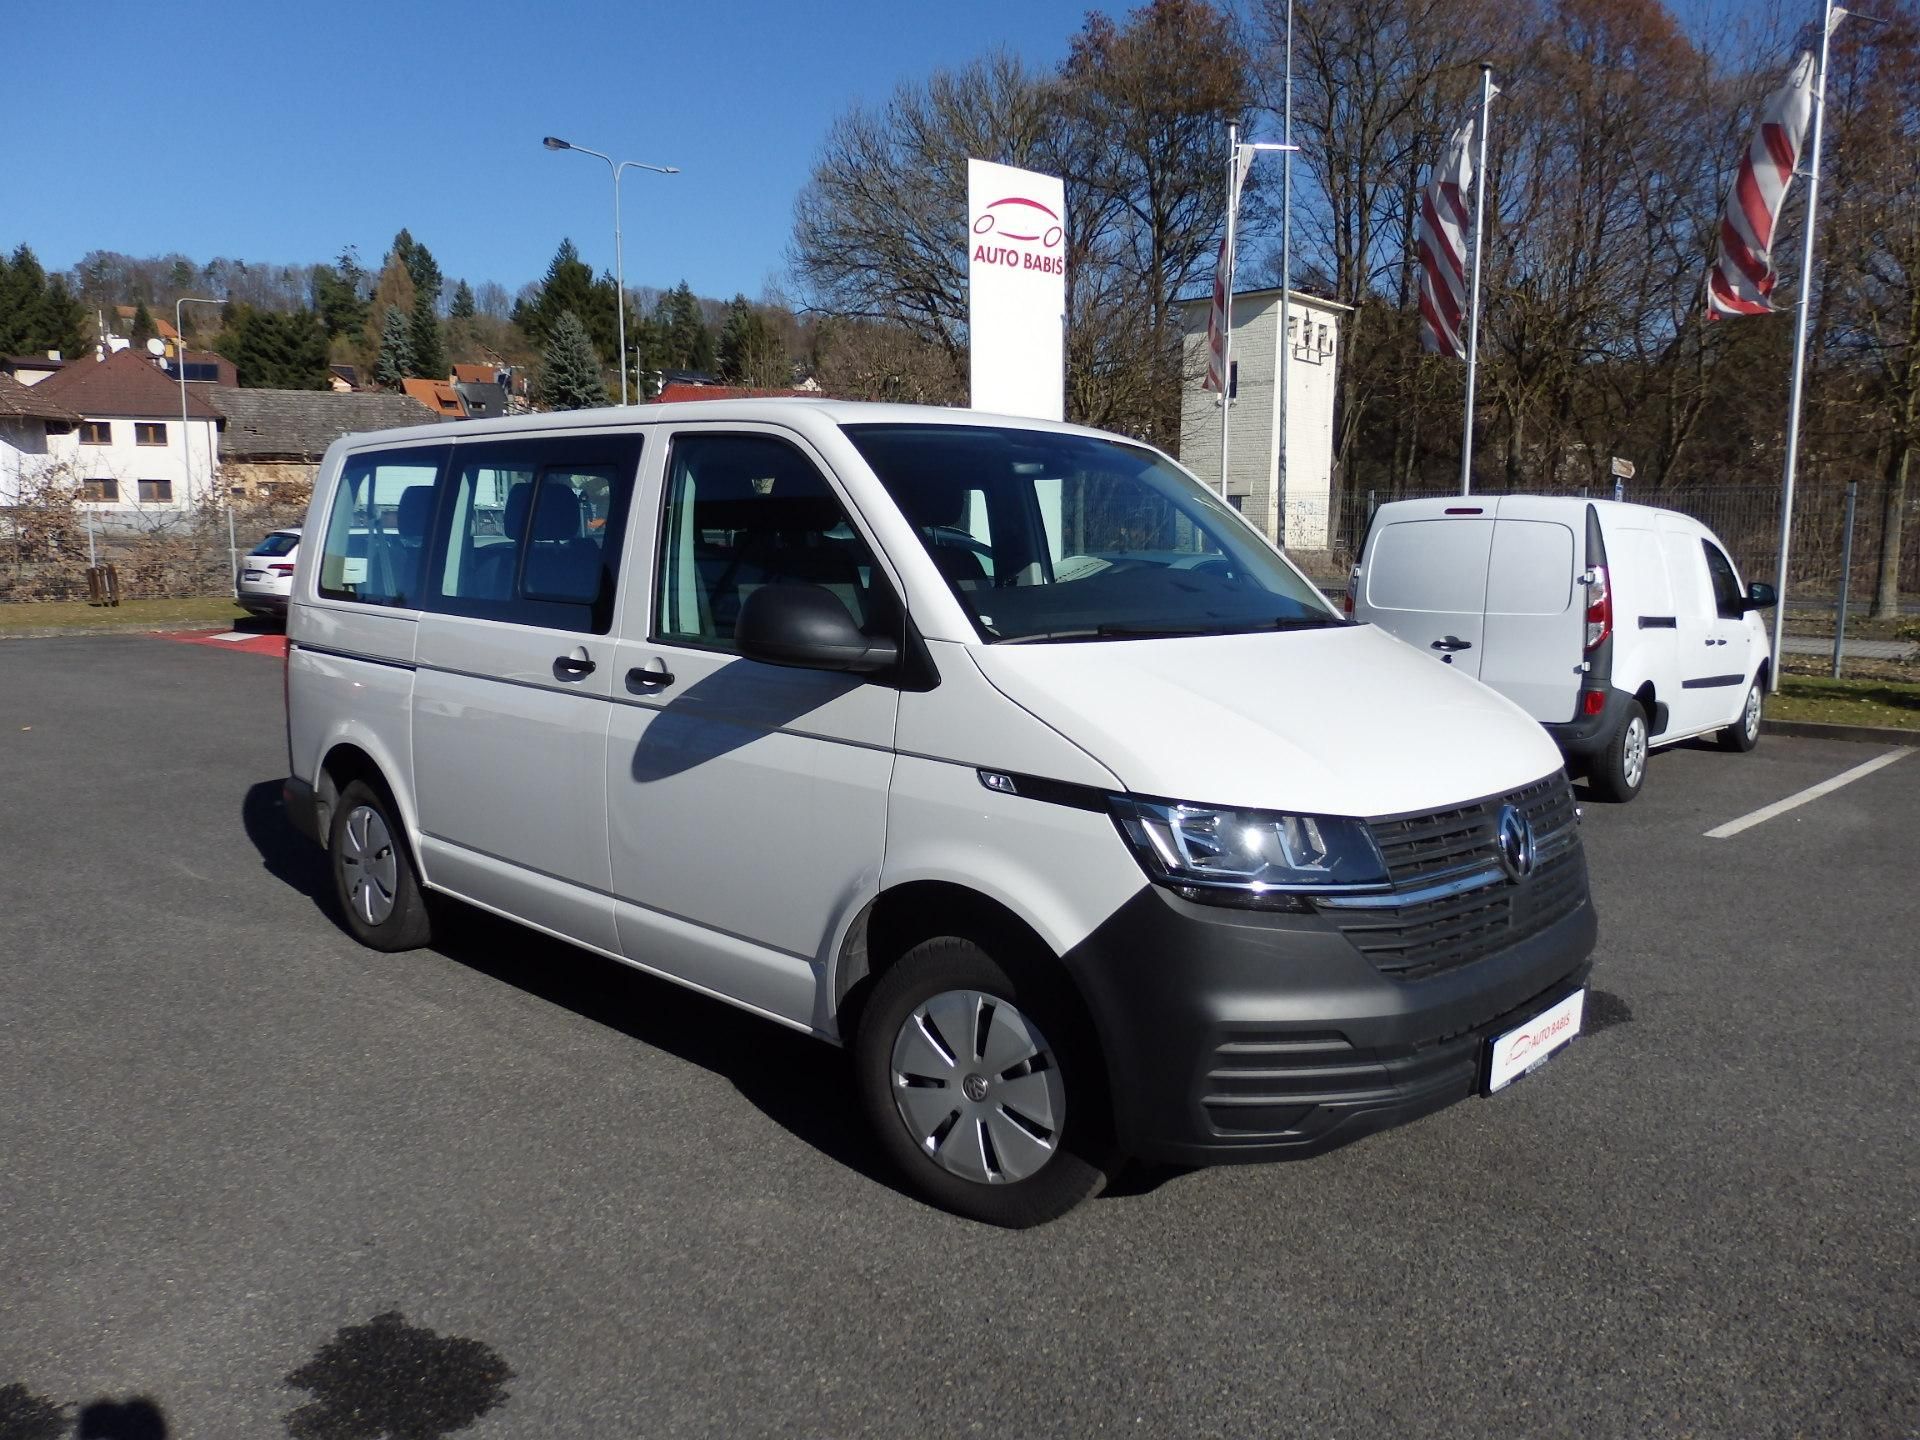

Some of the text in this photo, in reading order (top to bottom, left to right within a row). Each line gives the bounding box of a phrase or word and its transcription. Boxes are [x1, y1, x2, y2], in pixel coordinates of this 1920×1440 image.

[974, 245, 1063, 275] AUTO BABIŠ
[1530, 1026, 1550, 1048] AUTO
